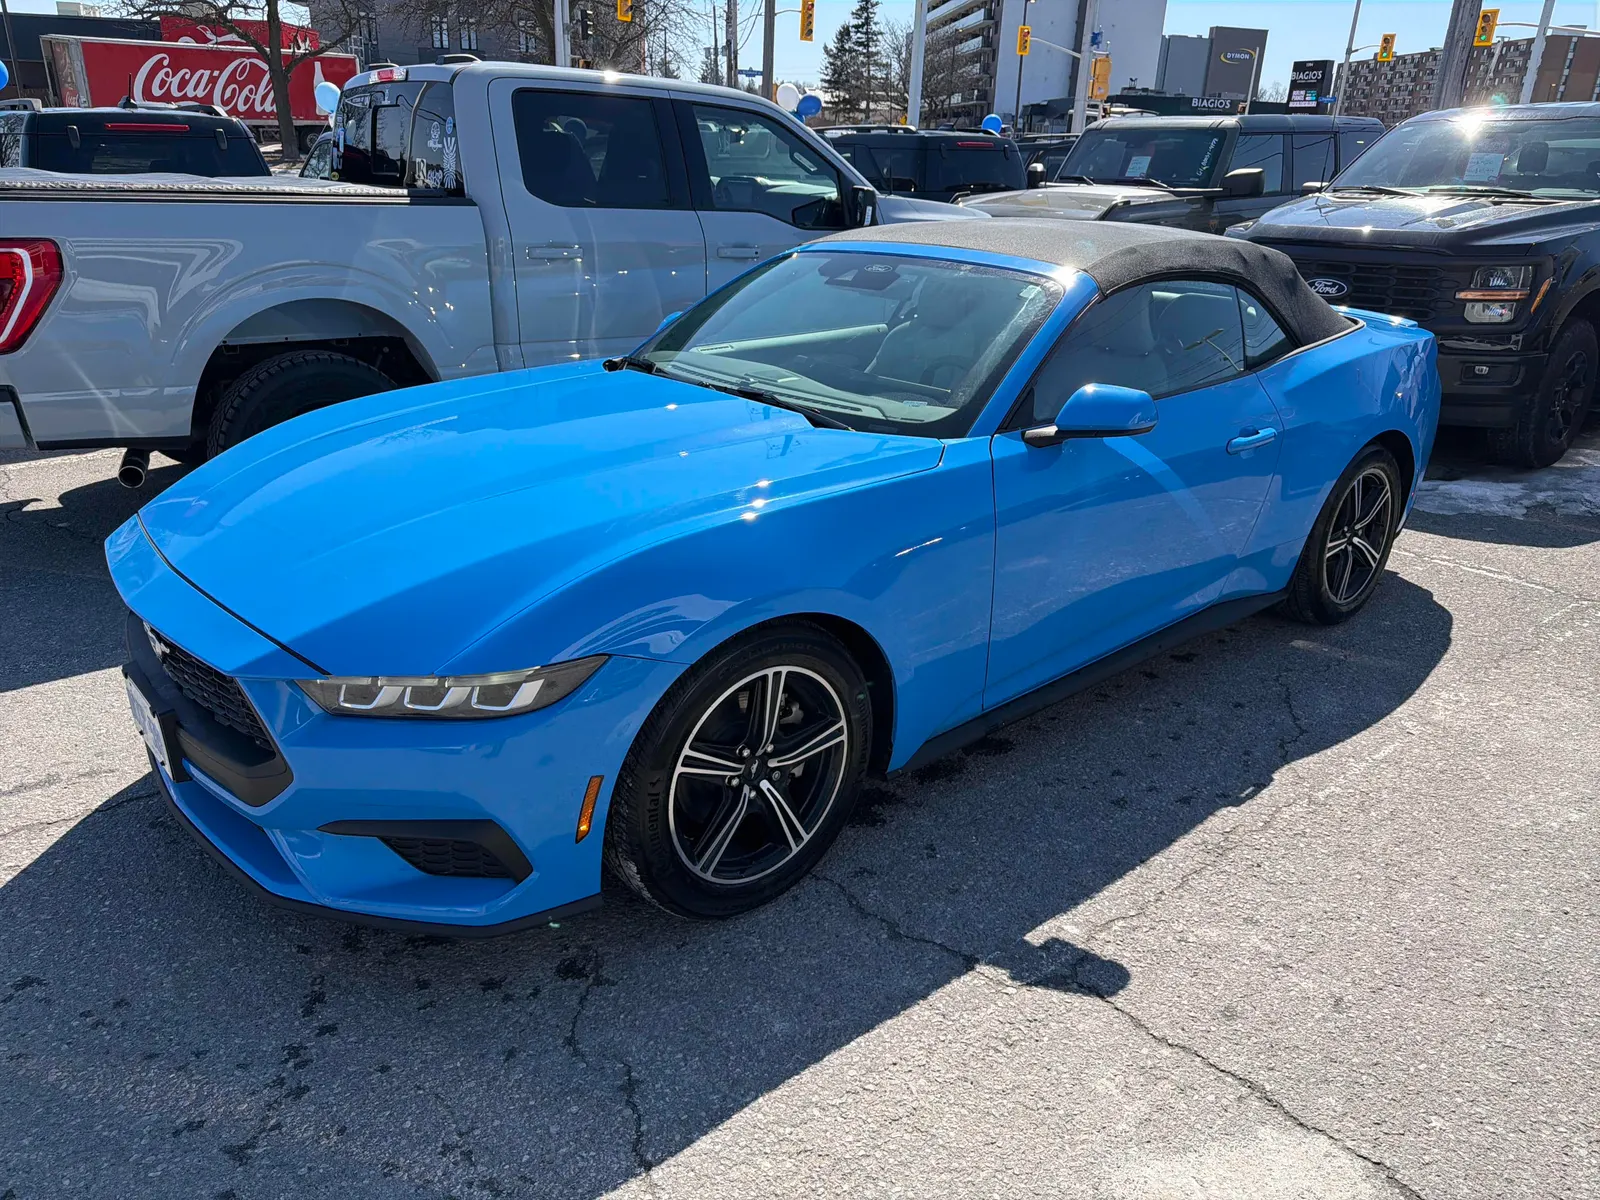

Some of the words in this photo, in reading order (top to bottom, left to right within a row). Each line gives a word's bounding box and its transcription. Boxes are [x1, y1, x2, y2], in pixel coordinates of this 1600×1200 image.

[1226, 52, 1250, 60] DYMON
[1291, 71, 1323, 80] BIAGIO'S
[1191, 98, 1232, 109] BIAGIO'S
[1311, 280, 1339, 294] Ford
